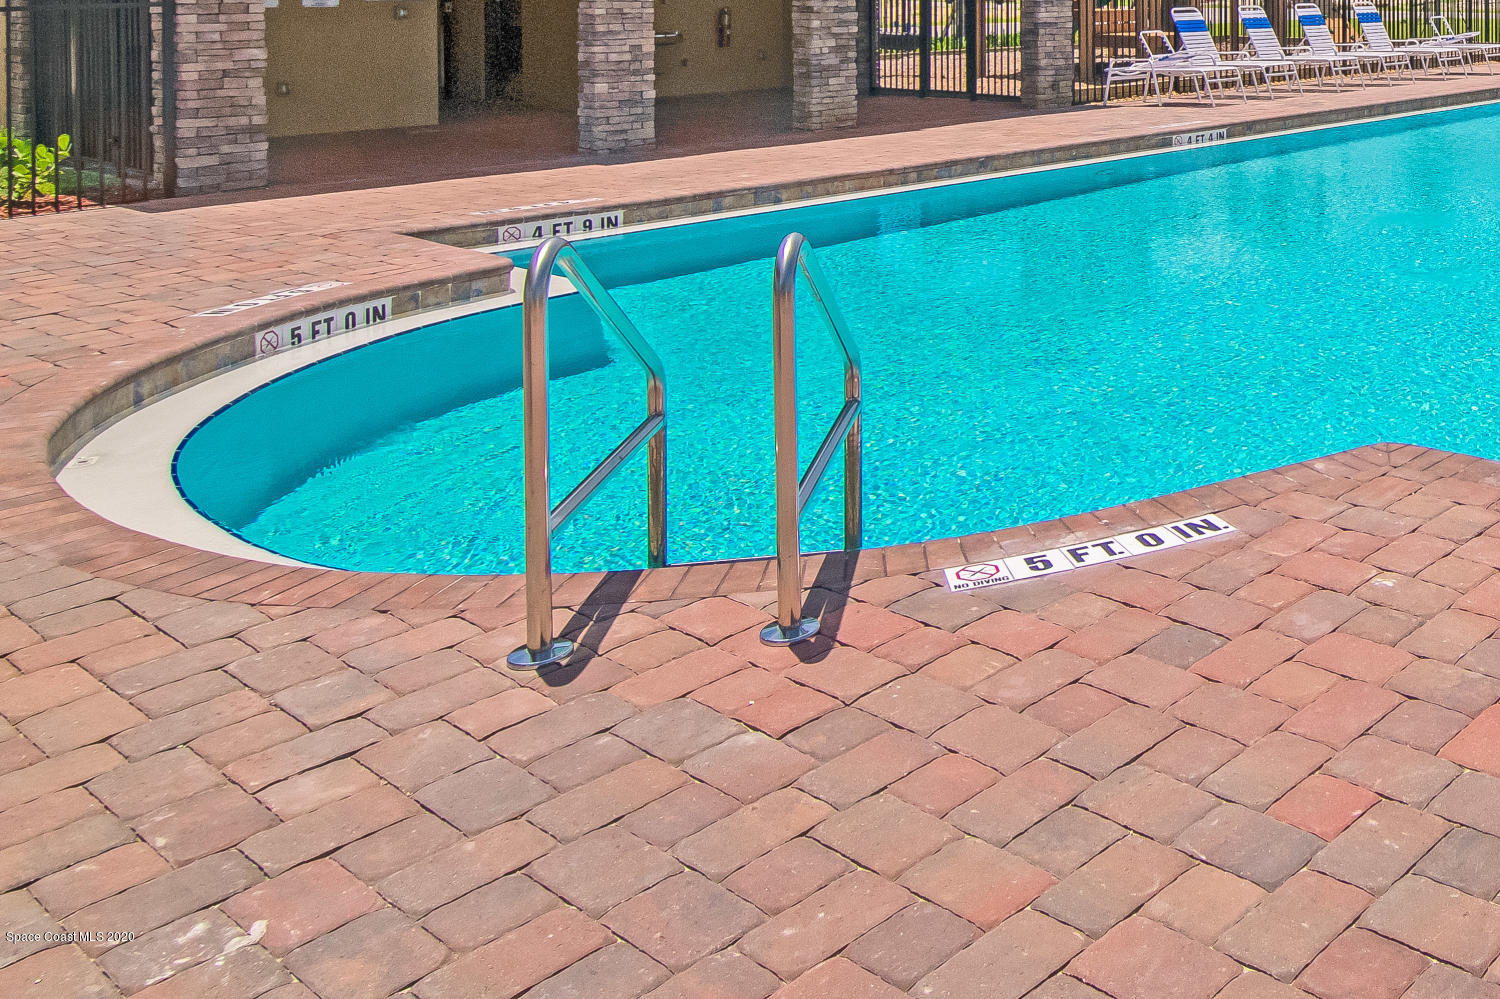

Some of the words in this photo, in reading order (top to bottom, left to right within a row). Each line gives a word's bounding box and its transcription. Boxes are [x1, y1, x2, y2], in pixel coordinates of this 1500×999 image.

[1187, 136, 1192, 144] 4
[1195, 134, 1205, 144] FT
[1208, 133, 1213, 141] 4
[1216, 130, 1225, 140] IN
[532, 225, 543, 238] 4
[552, 221, 574, 236] FT
[582, 218, 593, 232] 9
[600, 215, 619, 229] IN
[290, 325, 302, 346] 5
[311, 316, 334, 340] FT
[365, 303, 386, 325] IN
[1024, 554, 1055, 573] 5
[1066, 540, 1126, 564] FT.
[1136, 532, 1165, 549] 0
[1171, 518, 1230, 540] IN.
[972, 575, 1010, 587] DIVING
